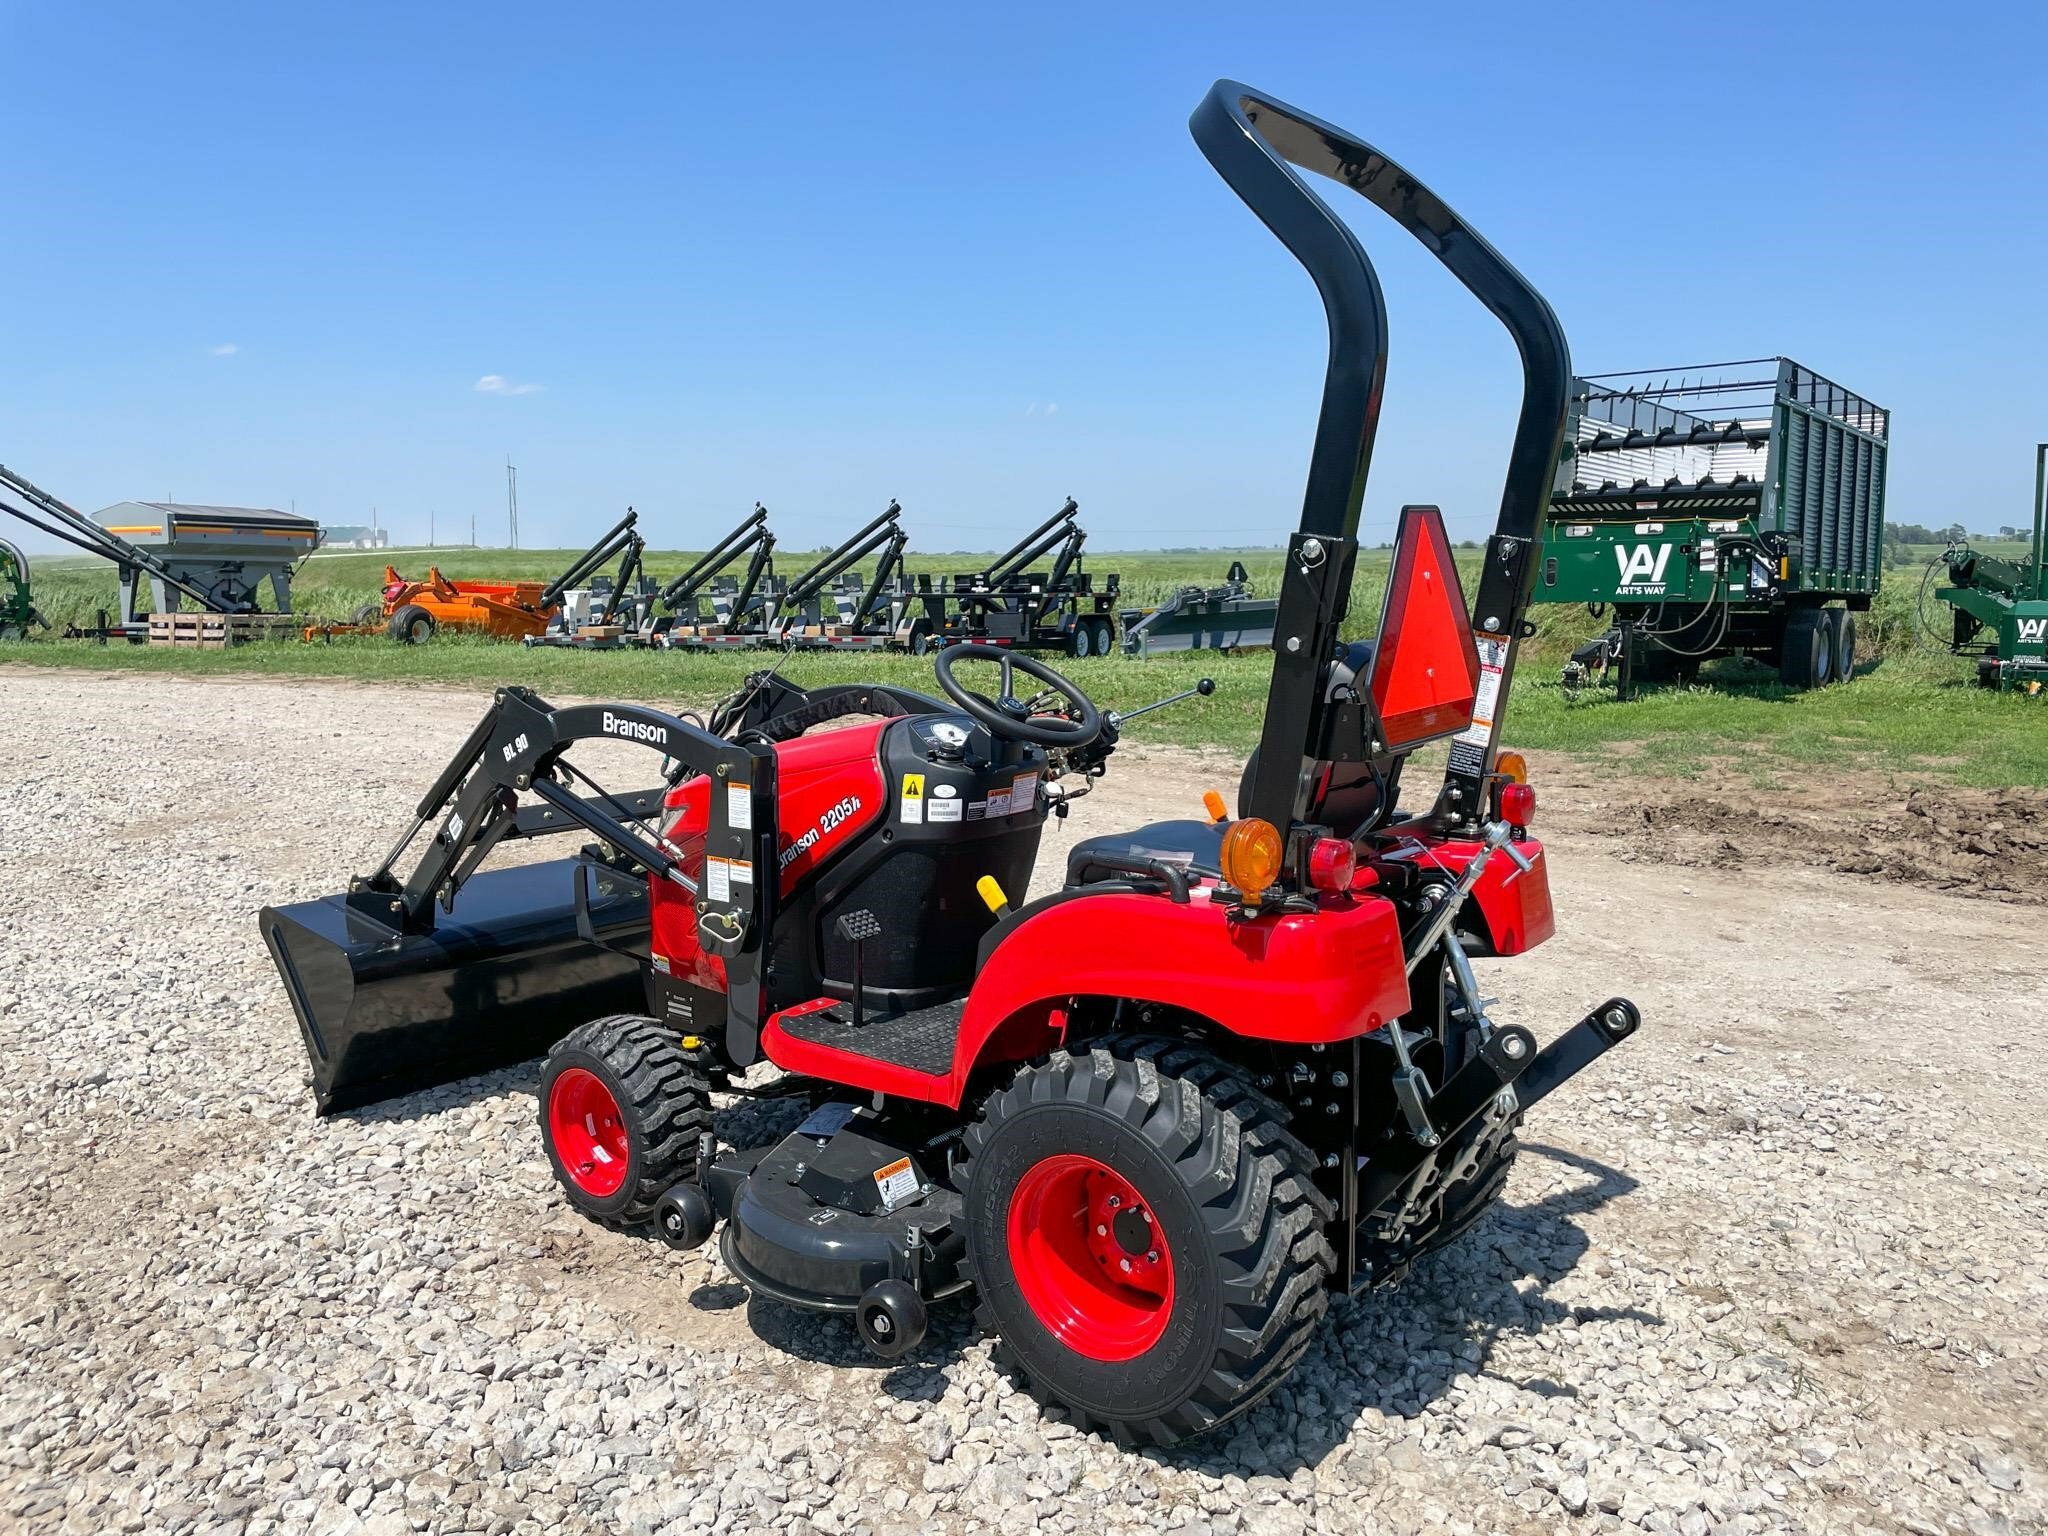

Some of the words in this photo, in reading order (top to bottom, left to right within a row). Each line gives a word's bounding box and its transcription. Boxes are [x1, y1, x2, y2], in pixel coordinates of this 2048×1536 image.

[1615, 586, 1643, 595] ART'S
[1643, 586, 1666, 595] WAY
[602, 711, 667, 744] Branson
[502, 742, 517, 762] BL
[514, 733, 529, 753] 90
[820, 796, 862, 834] 2205h
